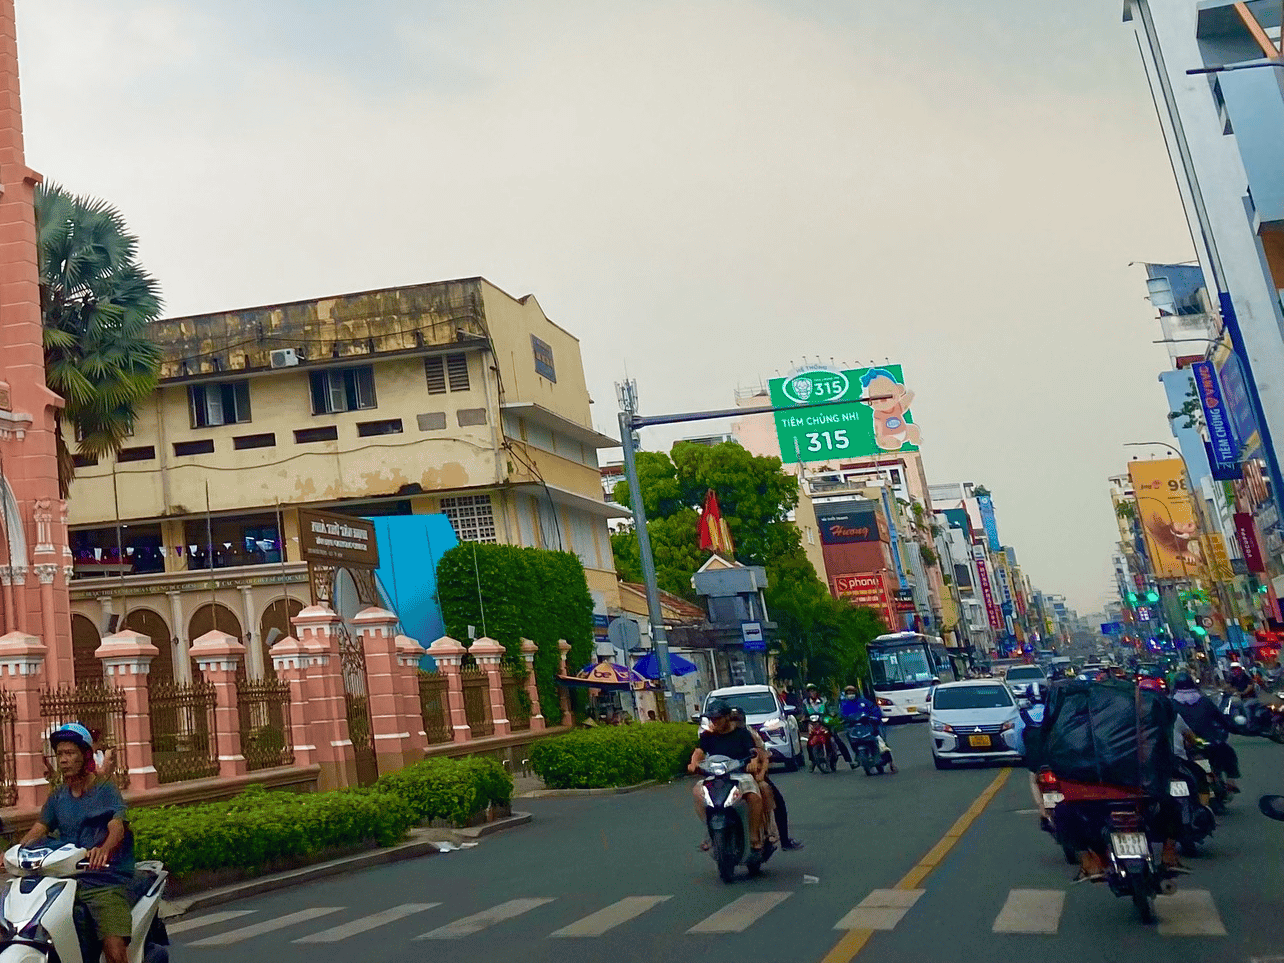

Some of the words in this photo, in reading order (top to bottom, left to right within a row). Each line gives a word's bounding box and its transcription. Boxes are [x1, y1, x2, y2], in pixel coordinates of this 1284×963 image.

[814, 381, 842, 396] 315
[781, 415, 805, 428] TIÊM
[806, 412, 840, 426] CHỦNG
[842, 411, 859, 423] NHI
[805, 429, 850, 453] 315
[593, 669, 612, 679] be
